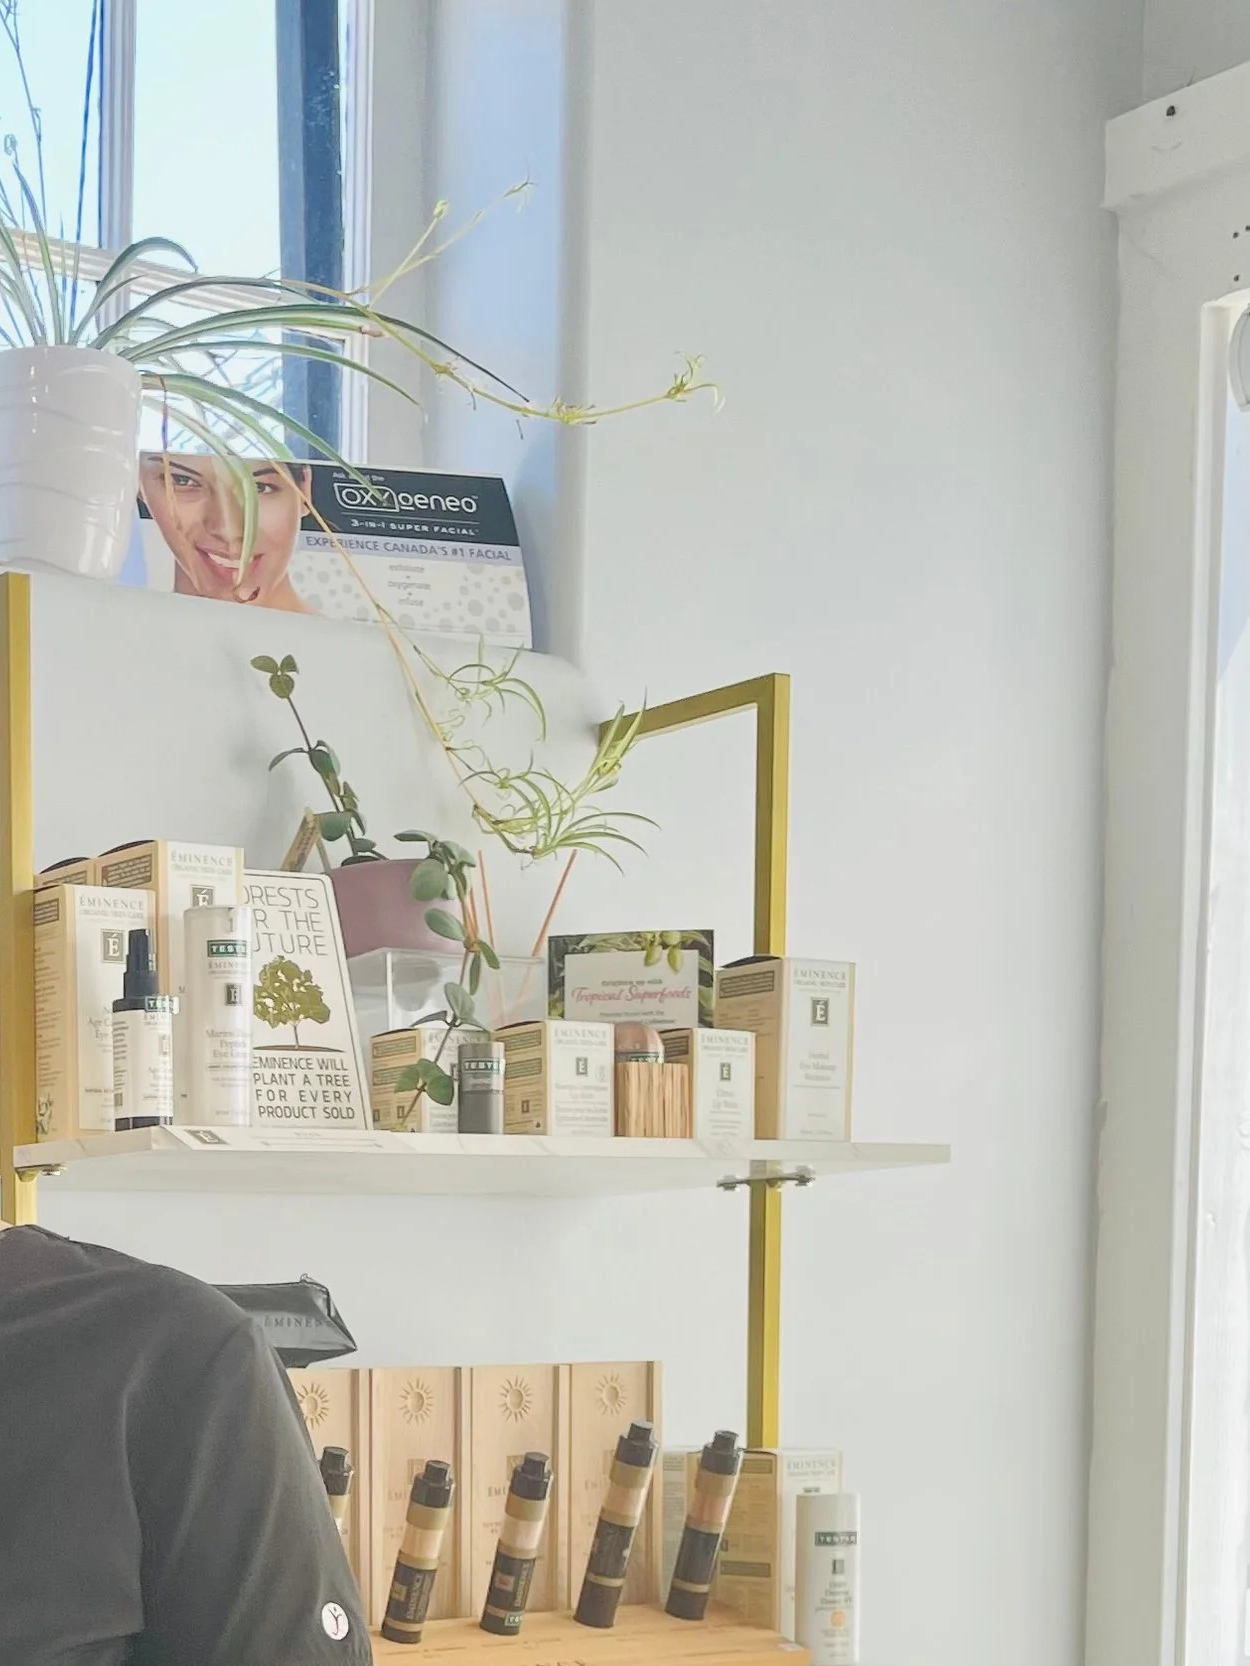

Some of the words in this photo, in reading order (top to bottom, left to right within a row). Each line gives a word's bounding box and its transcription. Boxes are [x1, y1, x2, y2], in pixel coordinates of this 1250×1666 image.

[389, 522, 430, 533] SUPER
[433, 526, 476, 536] FACIAL
[383, 541, 448, 556] CANADA'S
[451, 547, 465, 558] #1
[469, 548, 512, 561] FACIAL
[284, 910, 325, 933] THE
[106, 933, 121, 957] É
[254, 932, 328, 956] UTURE
[252, 1056, 314, 1071] EMINENCE
[316, 1058, 348, 1072] WILL
[253, 1073, 296, 1087] PLANT
[303, 1074, 312, 1086] A
[316, 1074, 350, 1088] TREE
[256, 1089, 288, 1103] FOR
[299, 1090, 352, 1104] EVERY
[258, 1106, 318, 1120] PRODUCT
[324, 1107, 355, 1121] SOLD
